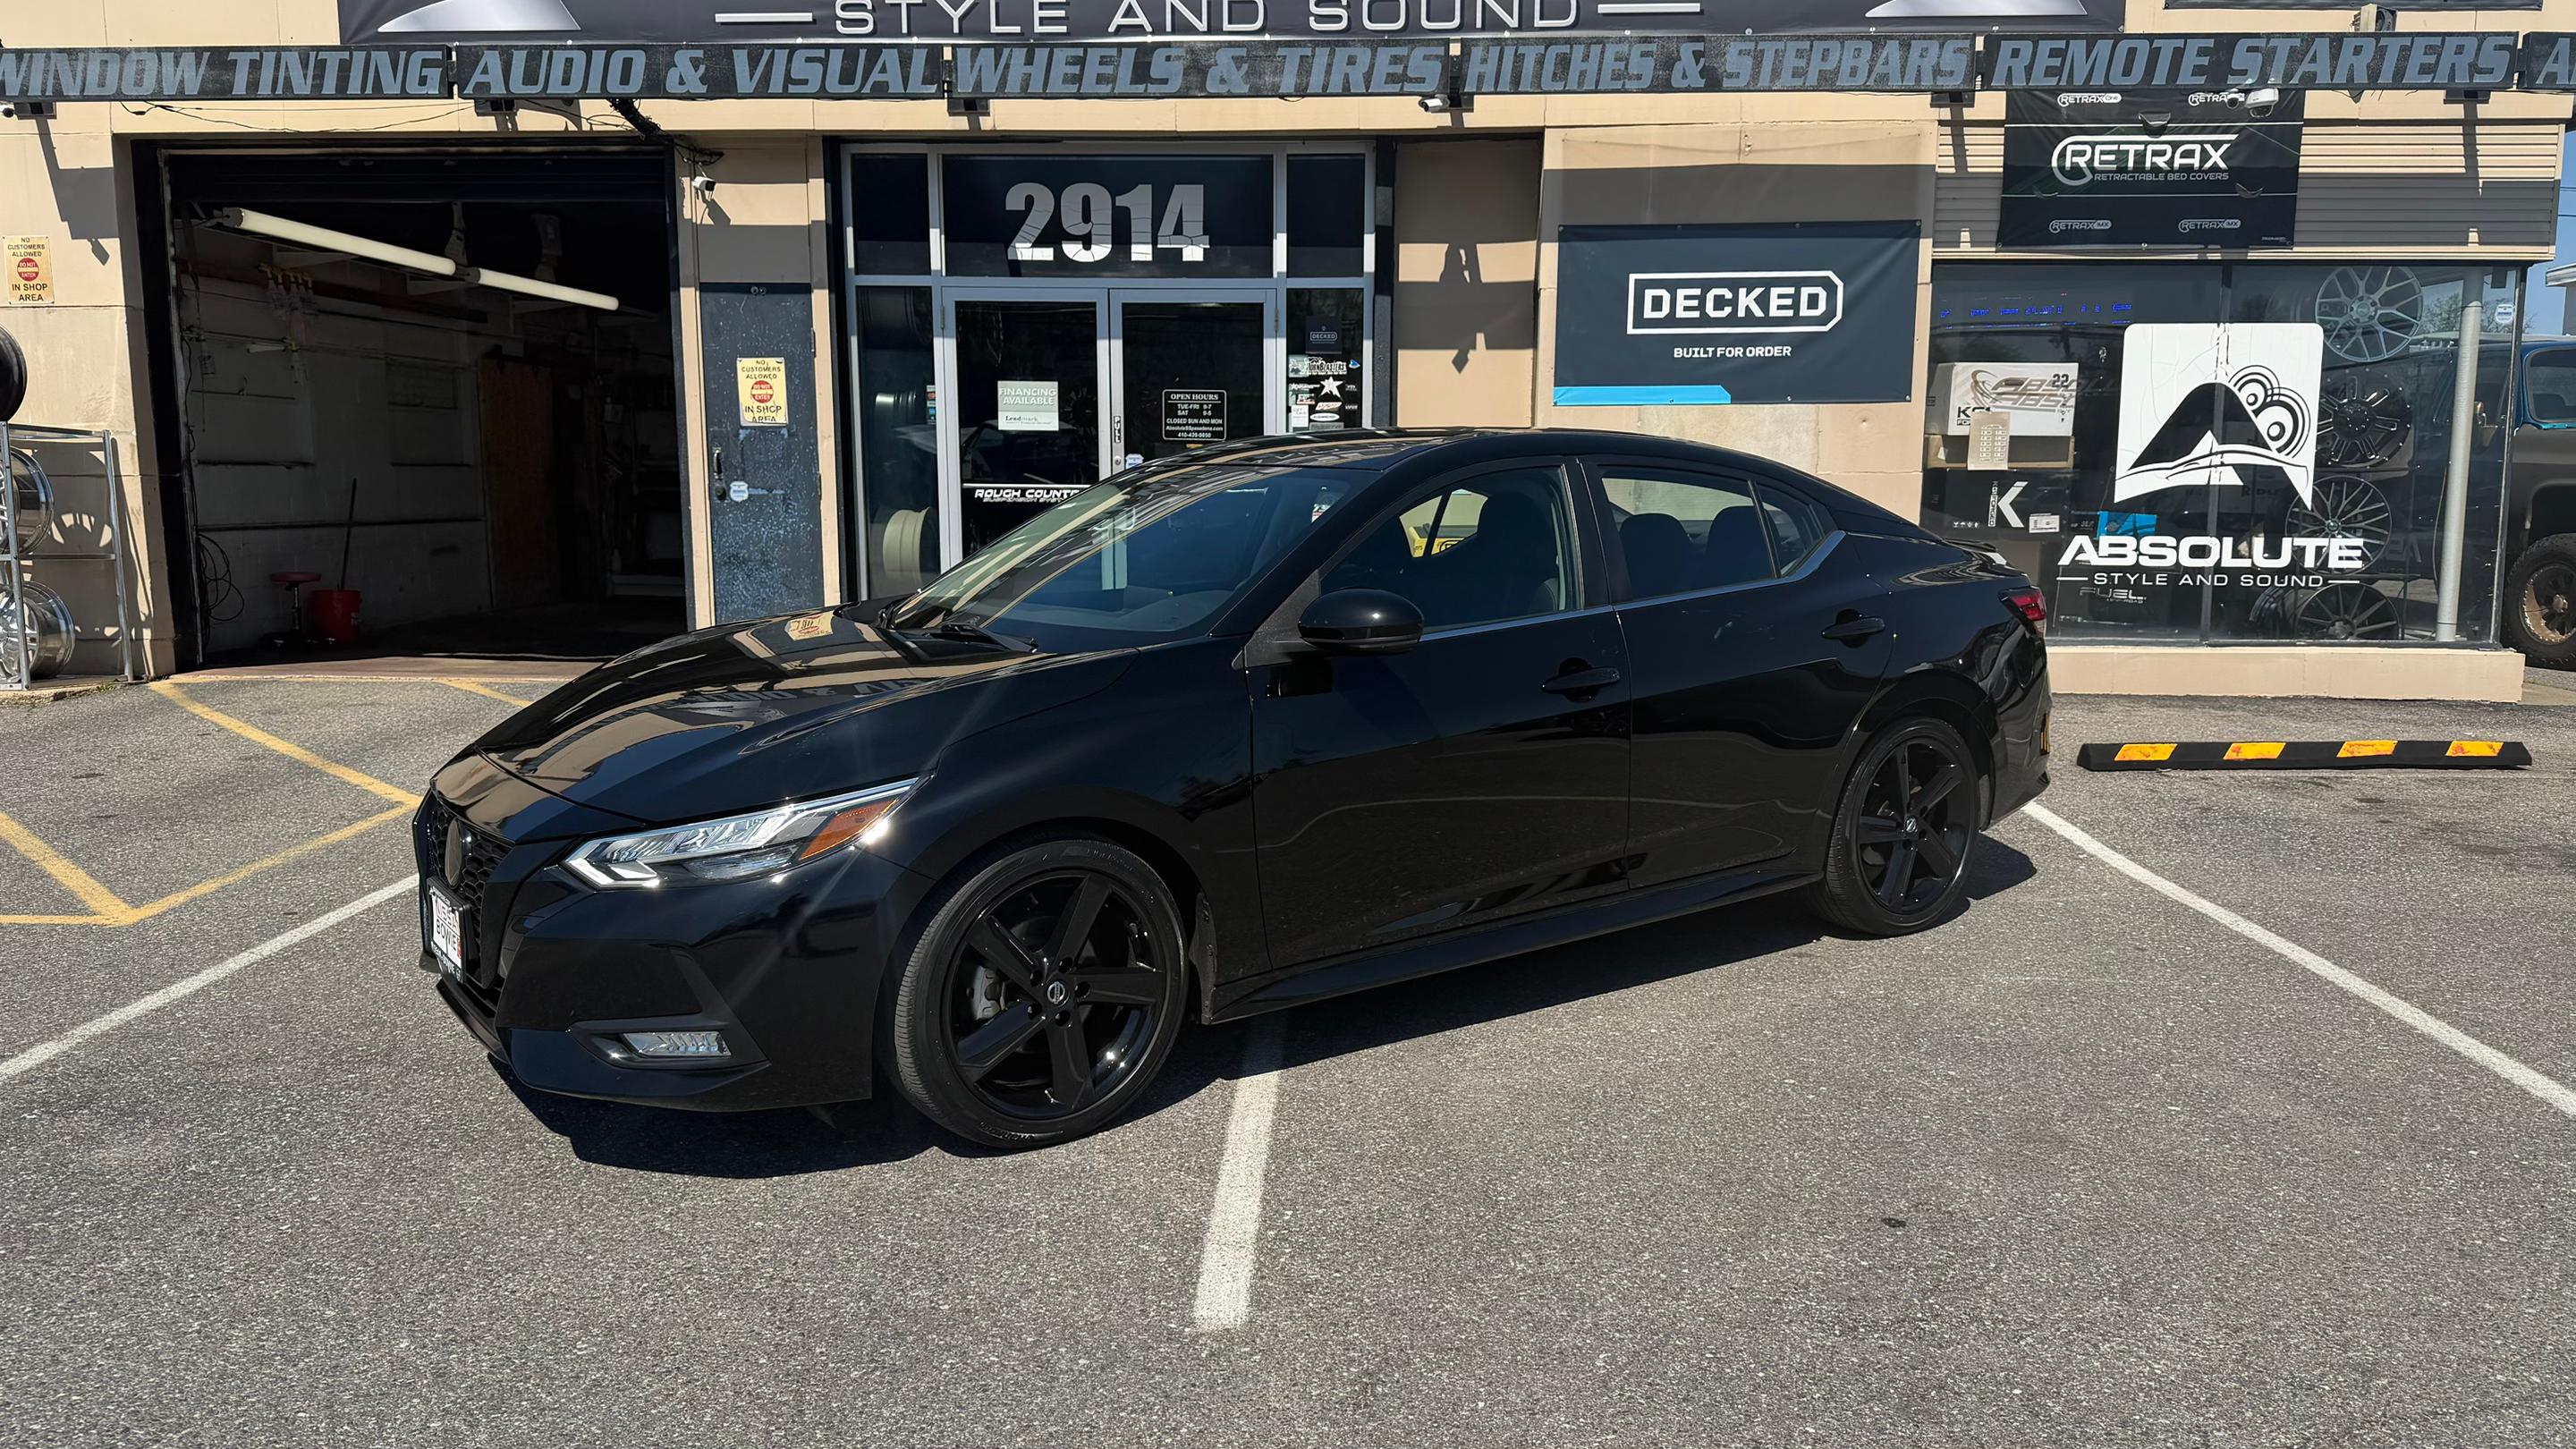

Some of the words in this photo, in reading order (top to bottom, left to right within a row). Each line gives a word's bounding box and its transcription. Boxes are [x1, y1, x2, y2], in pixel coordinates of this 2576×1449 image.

[835, 0, 1067, 35] STYLE
[1108, 0, 1266, 32] AND
[1309, 0, 1578, 31] SOUND
[1466, 43, 1657, 91] HITCHES
[1671, 42, 1707, 88] &
[1723, 38, 1973, 88] STEPBARS
[1991, 38, 2214, 87] REMOTE
[2228, 35, 2512, 86] STARTERS
[0, 51, 210, 96] WINDOW
[229, 50, 445, 95] TINTING
[463, 49, 647, 95] AUDIO
[665, 48, 708, 94] &
[732, 47, 939, 94] VISUAL
[954, 47, 1186, 94] WHEELS
[1205, 47, 1250, 93] &
[1276, 45, 1445, 93] TIRES
[2054, 140, 2233, 179] RETRAX
[2094, 173, 2165, 181] RETRACTABLE
[2168, 173, 2188, 181] BED
[2190, 172, 2229, 180] COVERS
[1005, 182, 1210, 262] 2914
[2050, 221, 2093, 232] RETRAX
[2180, 221, 2224, 231] RETRAX
[23, 283, 47, 291] SHOP
[19, 293, 44, 301] AREA
[1644, 286, 1827, 318] DECKED
[1674, 346, 1714, 358] BUILT
[1716, 346, 1743, 358] FOR
[1746, 345, 1792, 357] ORDER
[2052, 373, 2069, 388] 22
[1000, 387, 1057, 396] FINANCING
[1003, 396, 1055, 405] AVAILABLE
[757, 405, 782, 413] SHOP
[975, 489, 1021, 498] ROUGH
[2057, 534, 2365, 569] ABSOLUTE
[2094, 572, 2168, 586] STYLE
[2179, 573, 2229, 587] AND
[2240, 574, 2324, 587] SOUND
